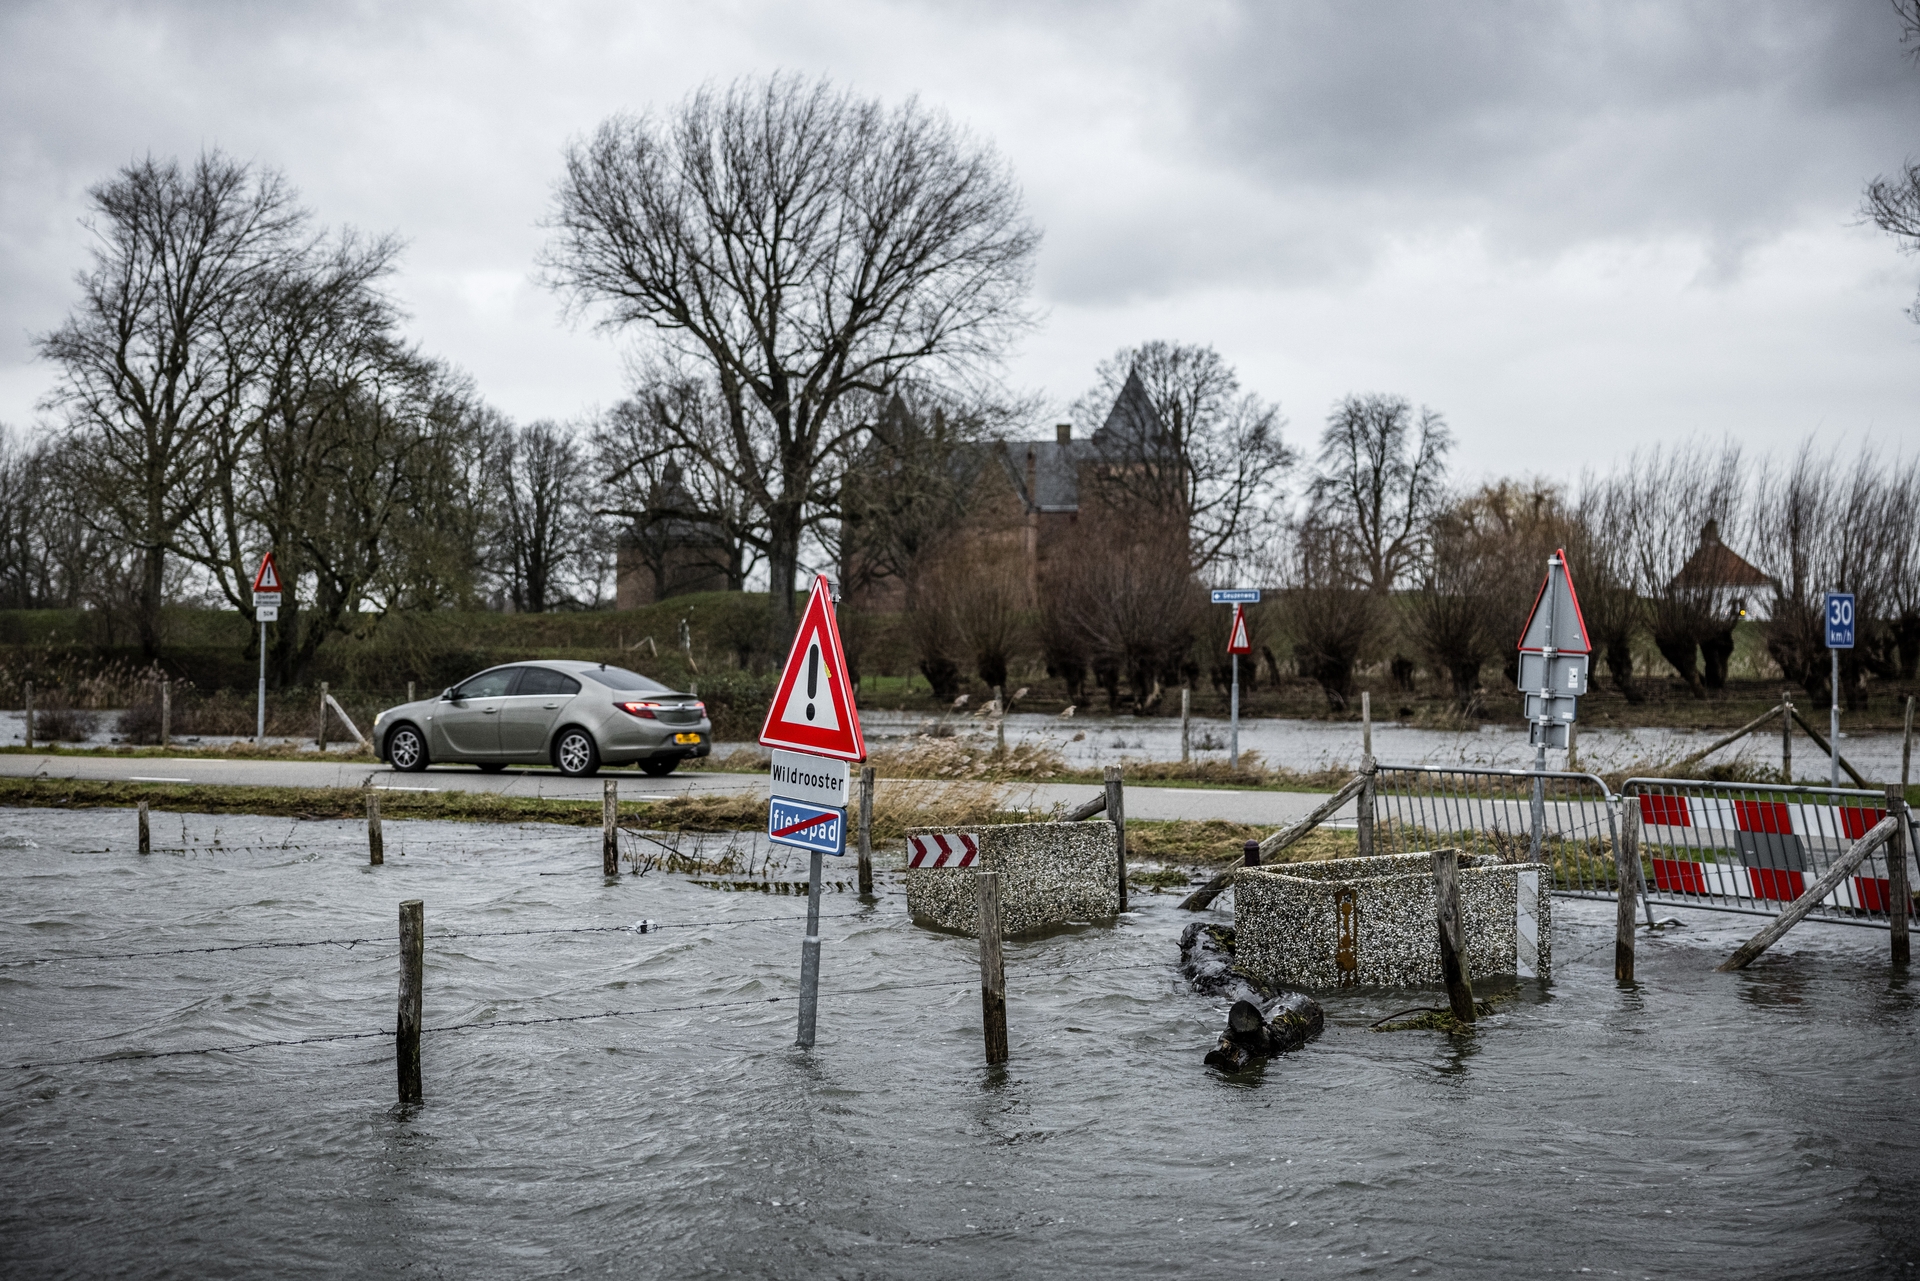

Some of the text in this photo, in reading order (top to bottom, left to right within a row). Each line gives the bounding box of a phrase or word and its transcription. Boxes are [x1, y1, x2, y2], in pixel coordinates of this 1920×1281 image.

[1831, 600, 1852, 626] 30
[1831, 630, 1852, 644] km/h
[773, 764, 844, 791] Wildrooster
[773, 809, 837, 842] fietspad
